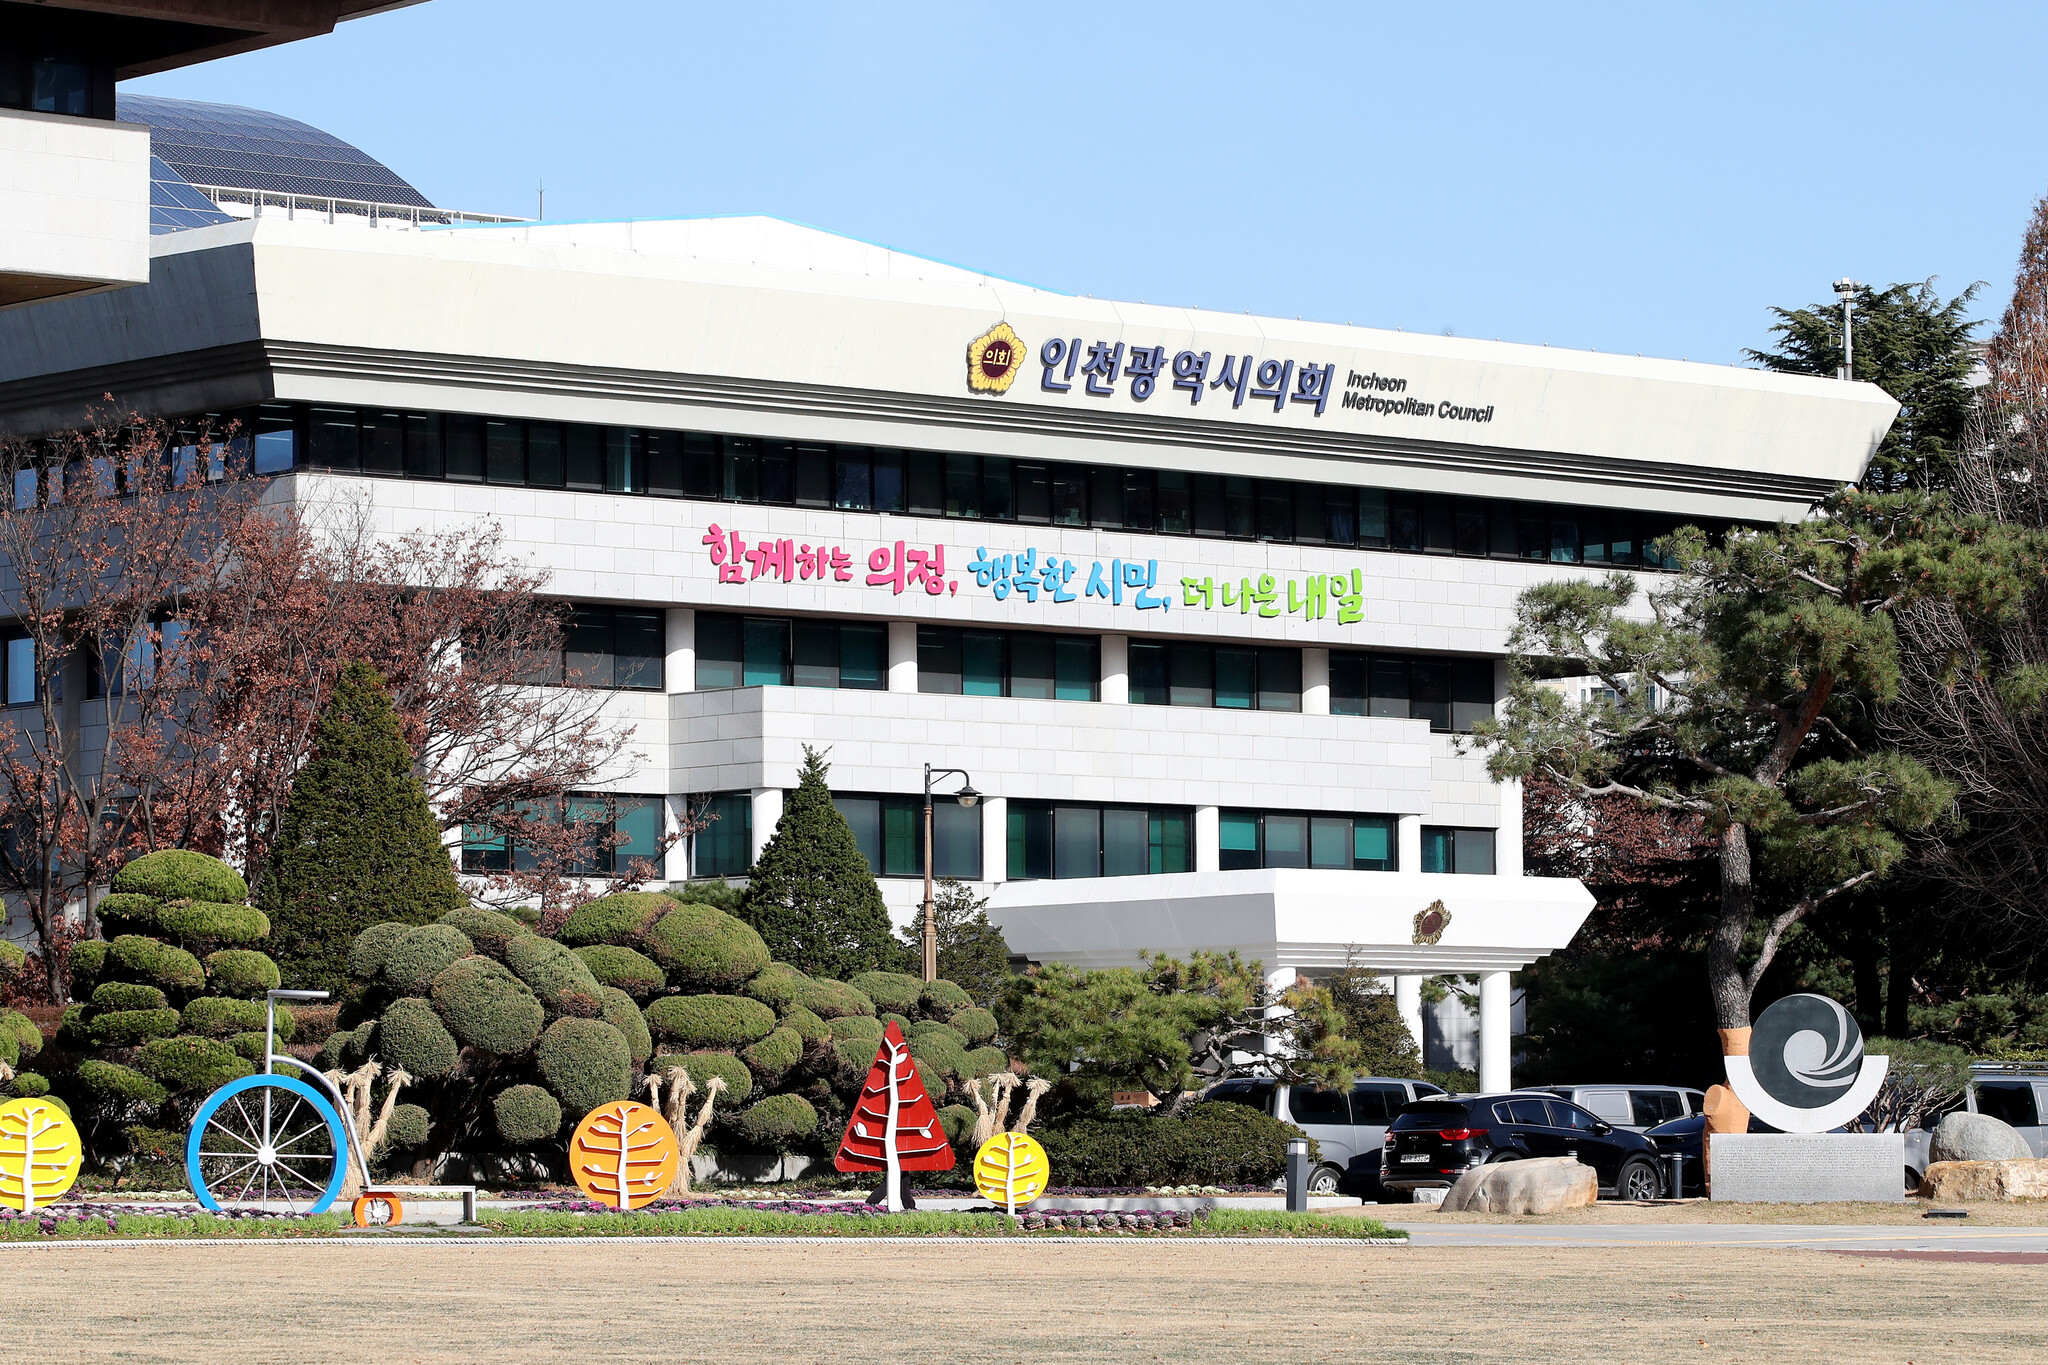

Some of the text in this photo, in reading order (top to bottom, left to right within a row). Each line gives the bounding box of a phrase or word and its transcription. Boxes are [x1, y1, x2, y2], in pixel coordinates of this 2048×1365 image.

[983, 349, 1011, 366] 의회
[1041, 337, 1335, 416] 인천광역시의회
[1346, 369, 1407, 392] Incheon
[1341, 391, 1494, 423] Metropolitan Council
[702, 523, 853, 583] 함께하는
[866, 540, 958, 596] 의정,
[967, 546, 1077, 603] 행복한
[1085, 558, 1171, 613] 시민,
[1287, 568, 1364, 625] 내일
